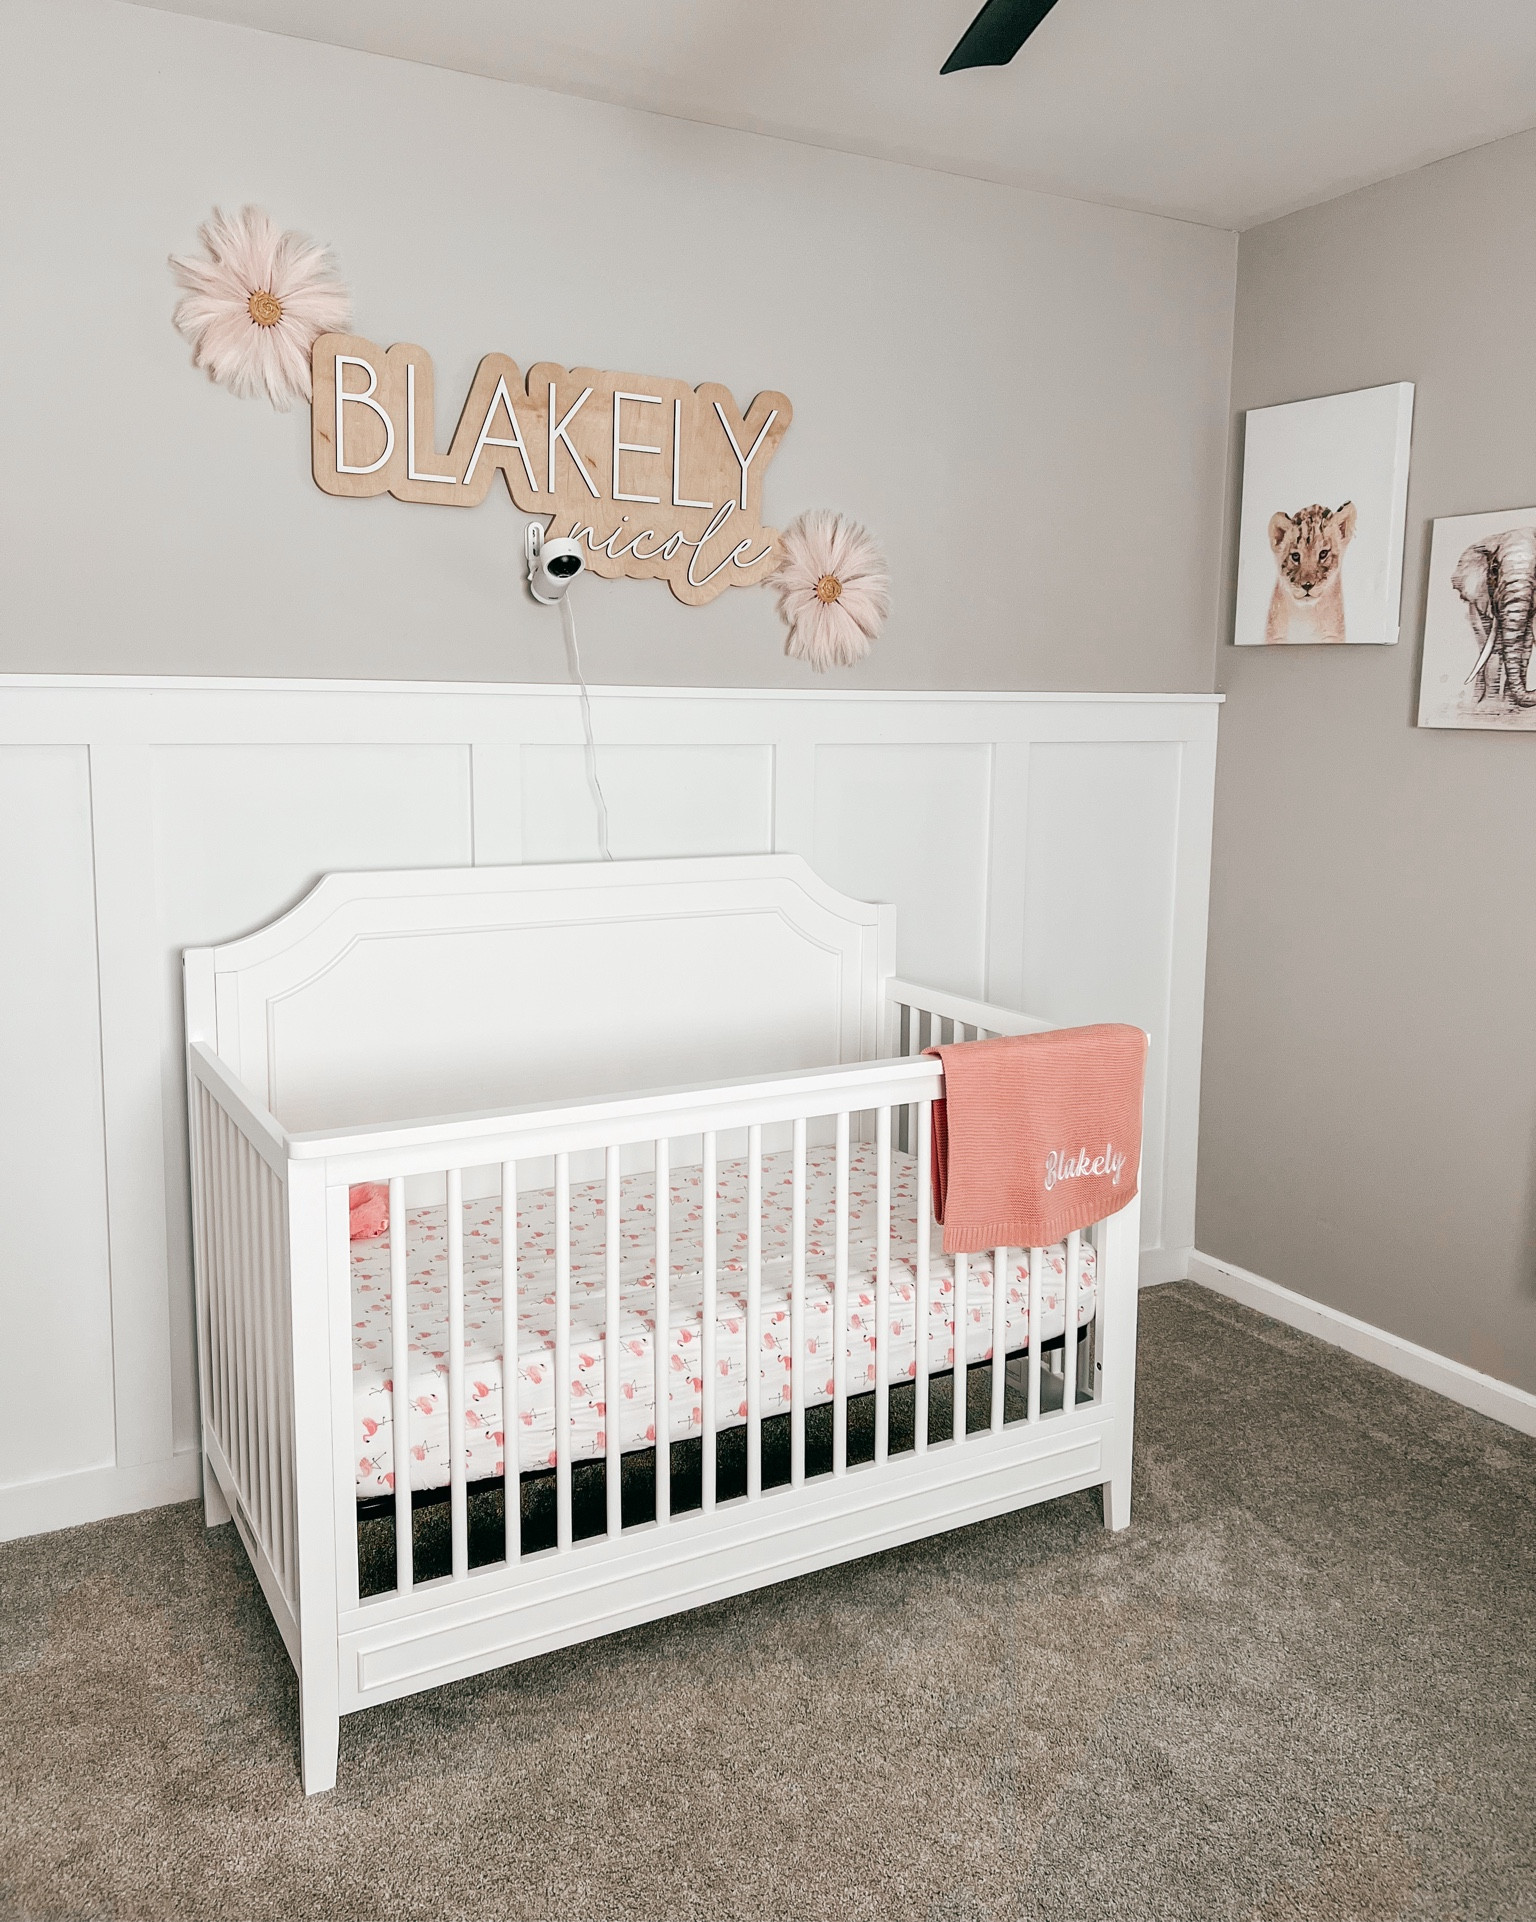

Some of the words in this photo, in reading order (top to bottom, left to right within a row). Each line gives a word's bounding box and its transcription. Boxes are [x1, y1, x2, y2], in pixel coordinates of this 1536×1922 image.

[335, 354, 778, 510] BLAKELY
[568, 499, 772, 586] nicole
[1044, 1143, 1126, 1191] Blakely
